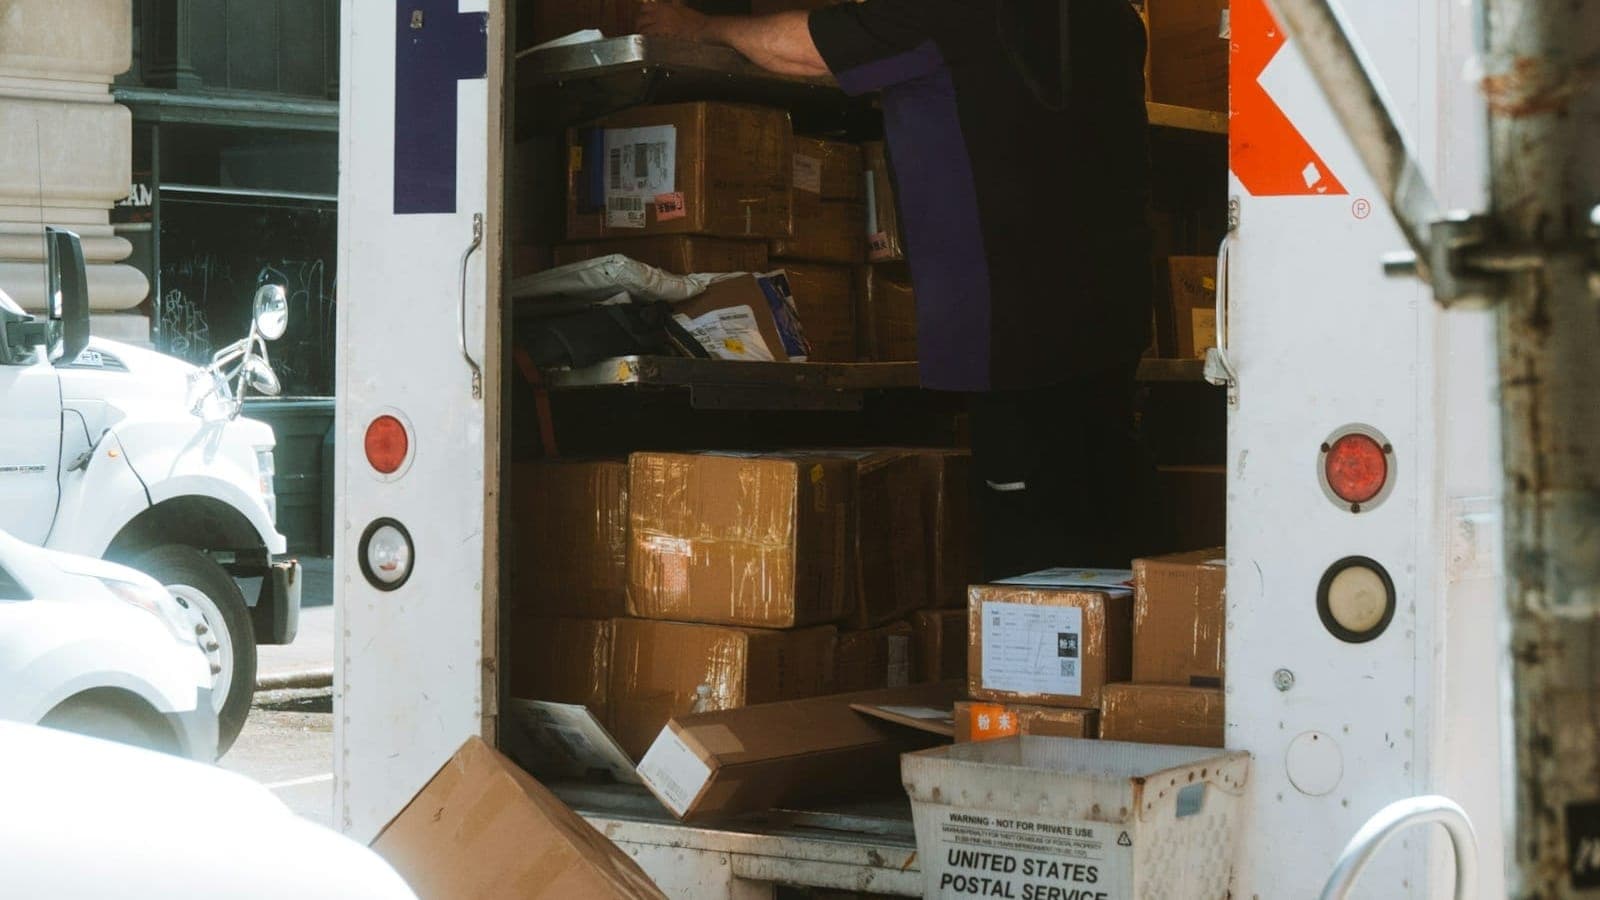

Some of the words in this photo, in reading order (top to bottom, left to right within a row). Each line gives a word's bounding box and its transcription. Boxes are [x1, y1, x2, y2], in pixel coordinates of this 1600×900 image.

[950, 813, 989, 826] WARNING
[996, 819, 1014, 829] NOT
[1016, 821, 1035, 831] FOR
[1036, 823, 1073, 836] PRIVATE
[1075, 828, 1094, 838] USE
[947, 848, 1017, 873] UNITED
[1022, 858, 1099, 884] STATES
[940, 873, 1015, 899] POSTAL
